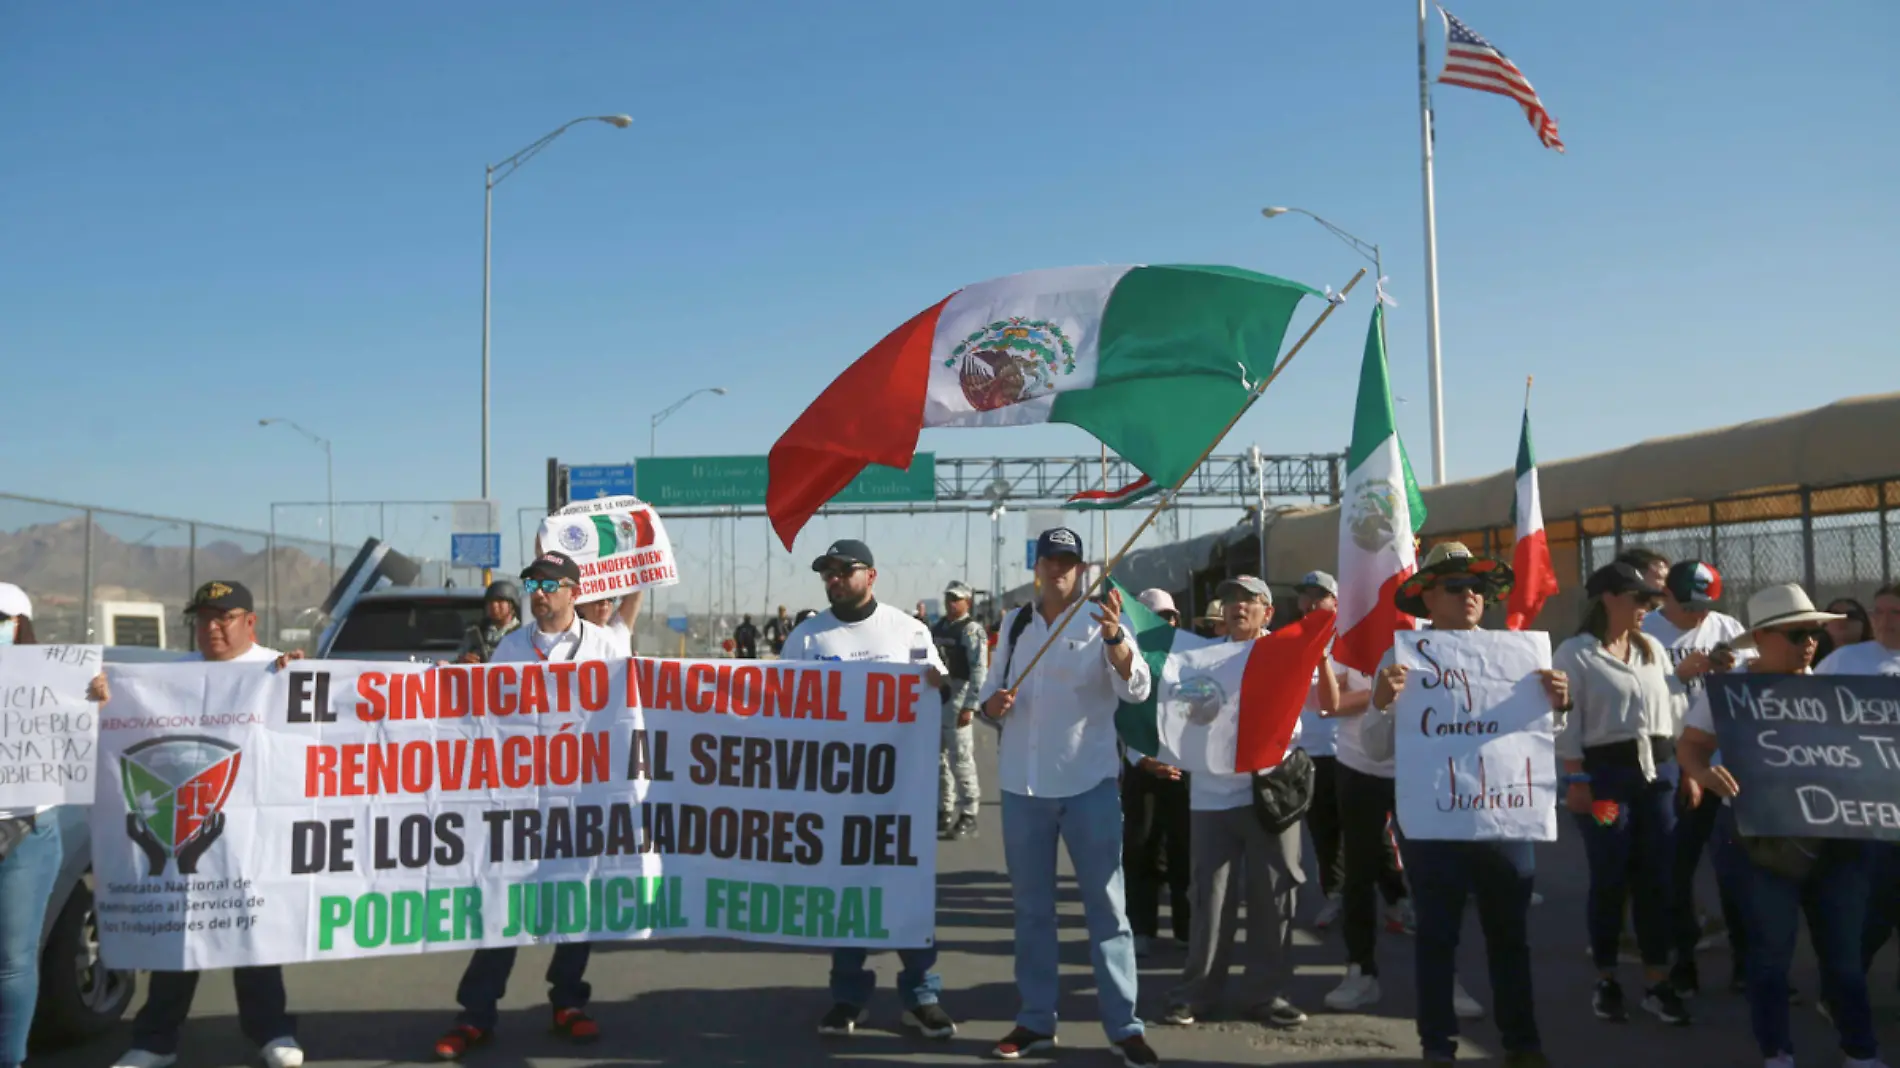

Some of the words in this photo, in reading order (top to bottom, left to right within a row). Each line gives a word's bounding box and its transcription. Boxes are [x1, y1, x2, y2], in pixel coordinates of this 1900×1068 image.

[608, 575, 624, 591] DE
[624, 571, 639, 587] LA
[287, 671, 337, 724] EL
[355, 660, 610, 724] SINDICATO
[626, 657, 848, 722] NACIONAL
[864, 672, 920, 723] DE
[1416, 638, 1473, 714] Soy
[200, 712, 264, 727] SINDICAL
[305, 722, 610, 798] RENOVACIÓN
[627, 729, 674, 782] AL
[689, 733, 897, 794] SERVICIO
[1435, 755, 1534, 813] Judicial
[291, 818, 354, 875] DE
[374, 811, 465, 870] LOS
[483, 802, 824, 866] TRABAJADORES
[840, 814, 918, 866] DEL
[165, 878, 229, 893] Nacional
[233, 877, 252, 890] de
[184, 897, 242, 912] Servicio
[246, 896, 265, 909] de
[318, 886, 483, 951] PODER
[502, 875, 689, 938] JUDICIAL
[705, 876, 889, 939] FEDERAL
[208, 917, 231, 930] del
[236, 915, 259, 931] PJF
